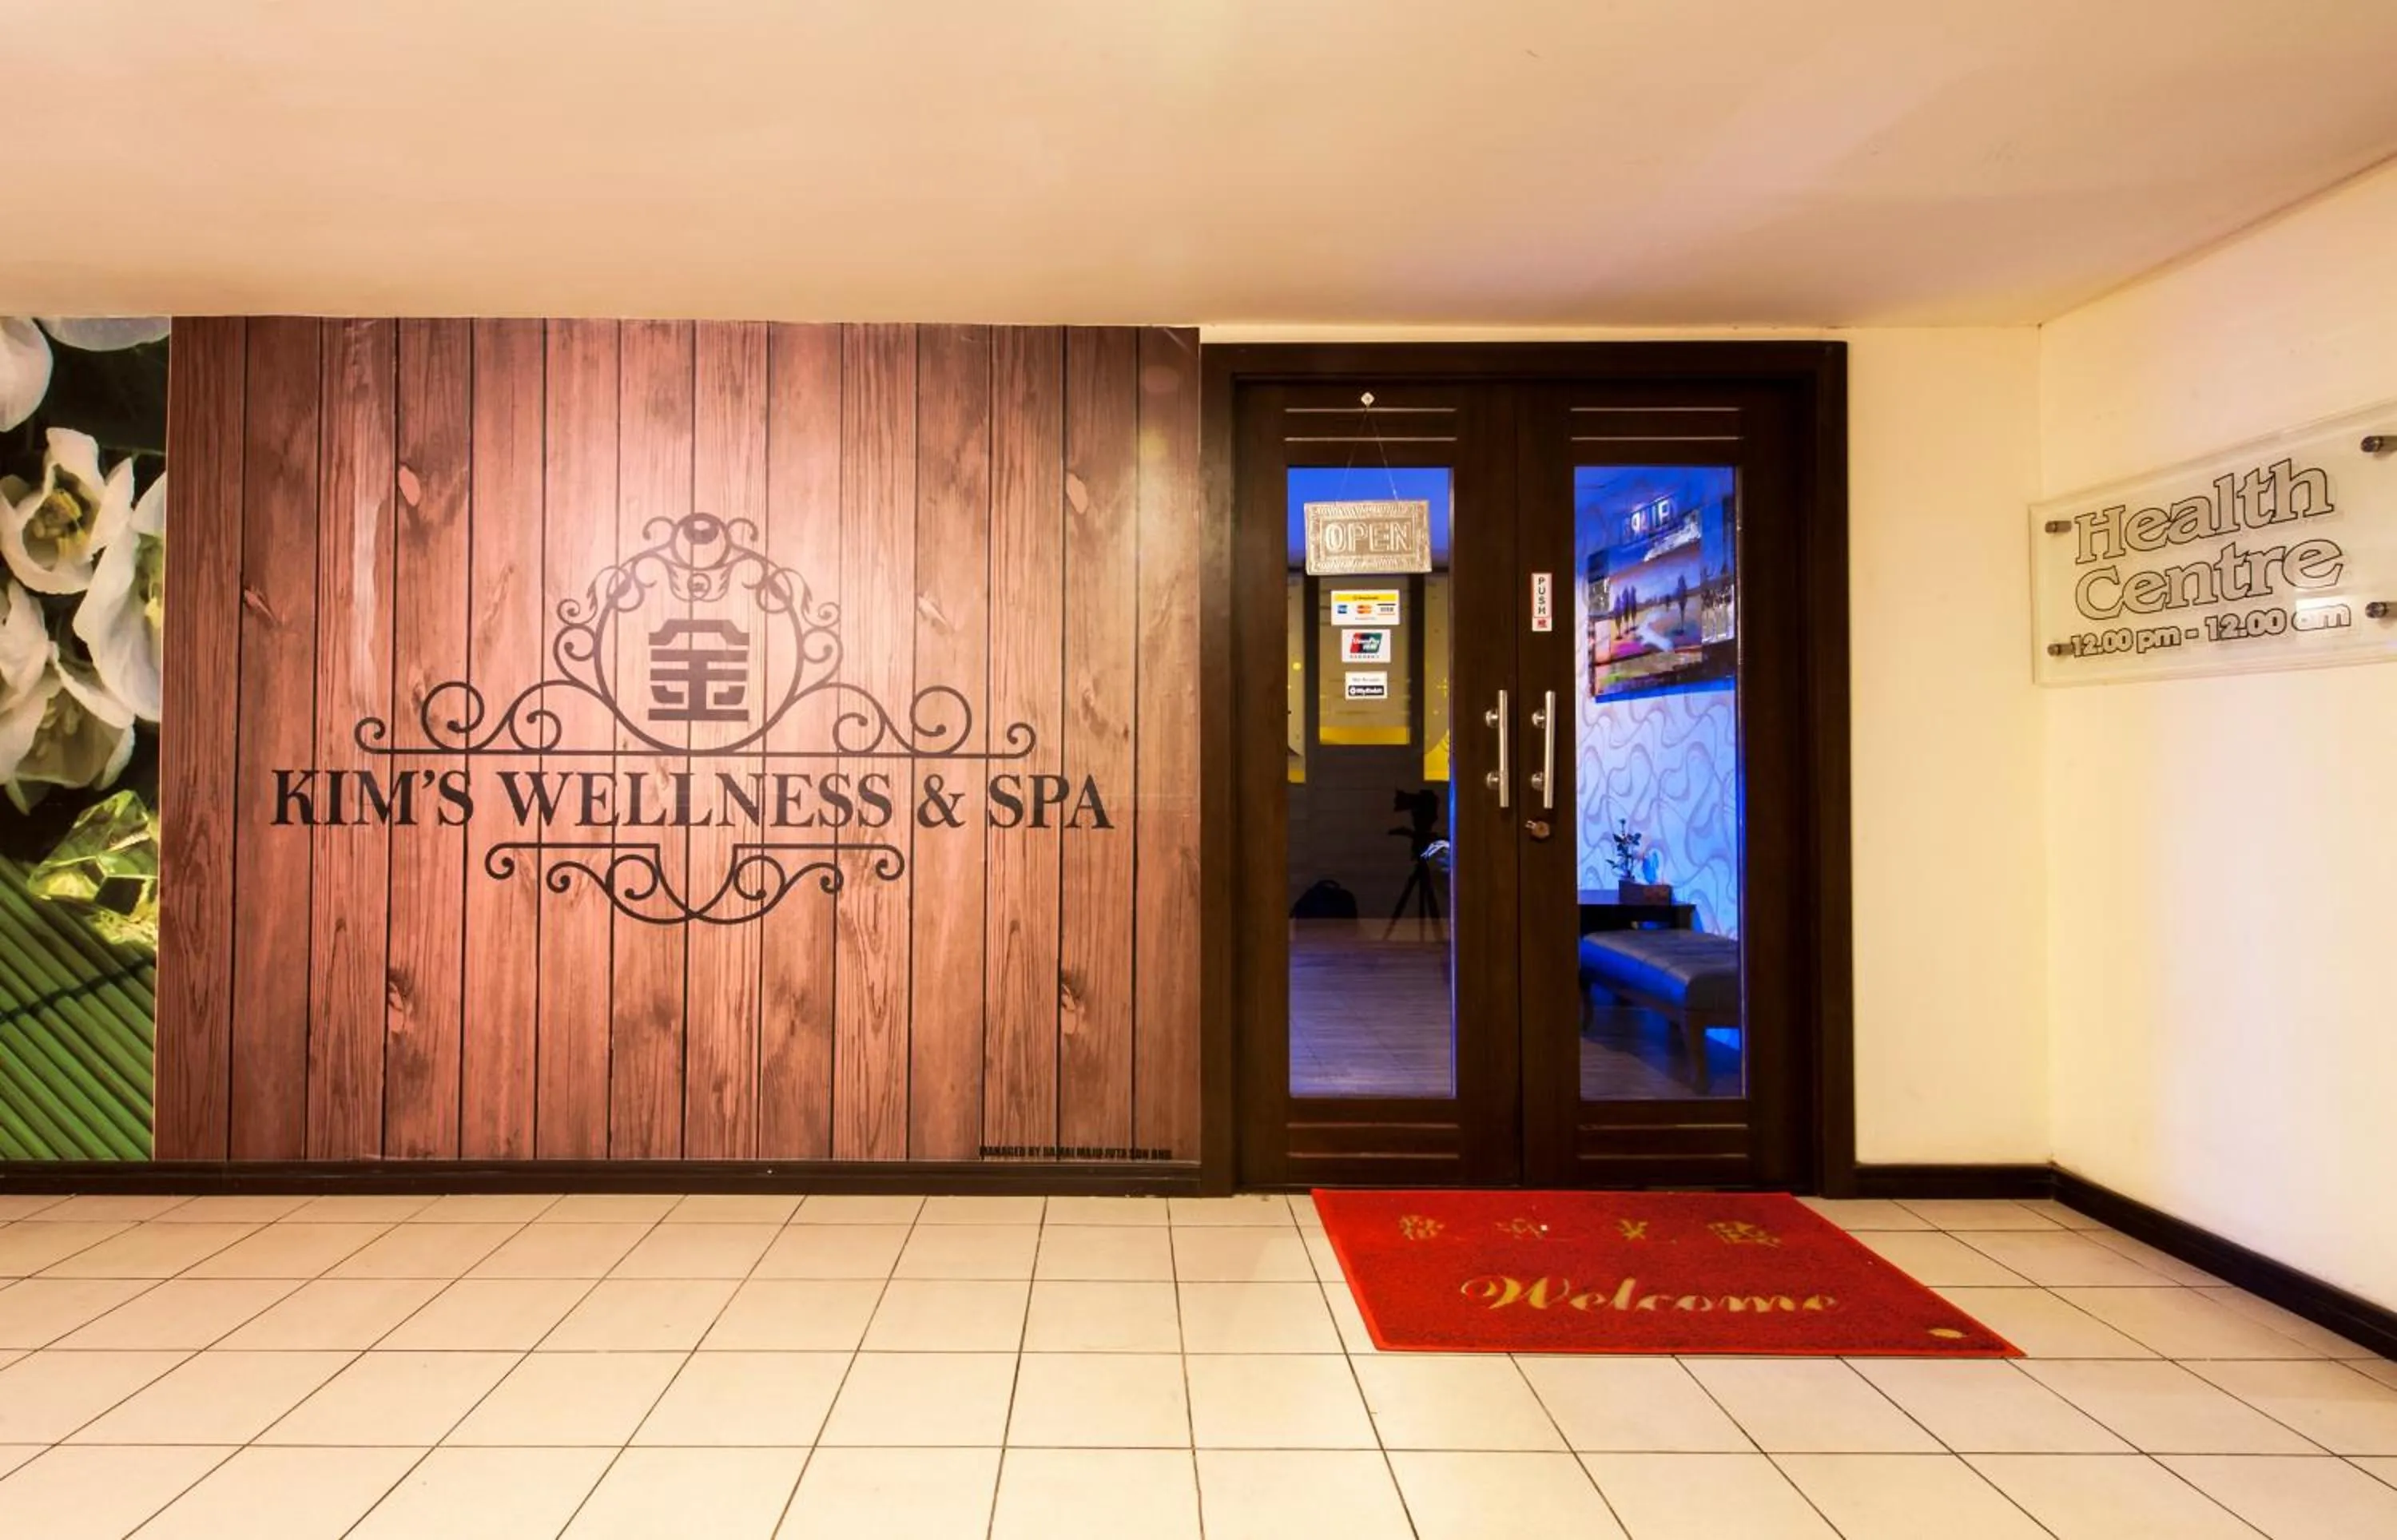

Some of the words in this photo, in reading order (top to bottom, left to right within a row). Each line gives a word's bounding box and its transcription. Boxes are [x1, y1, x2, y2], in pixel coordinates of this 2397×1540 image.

[1325, 521, 1412, 553] OPEN
[2075, 458, 2334, 565] Health
[1537, 576, 1546, 615] PUSH
[2075, 538, 2343, 620] Centre
[2071, 628, 2134, 657] 12.00
[2136, 625, 2181, 653] pm
[2204, 607, 2288, 641] 12.00
[2291, 603, 2351, 631] am
[646, 617, 751, 722] 金
[270, 768, 475, 828] KIM'S
[496, 770, 895, 828] WELLNESS
[916, 774, 966, 829] &
[987, 772, 1115, 831] SPA
[1460, 1276, 1840, 1313] Welcome
